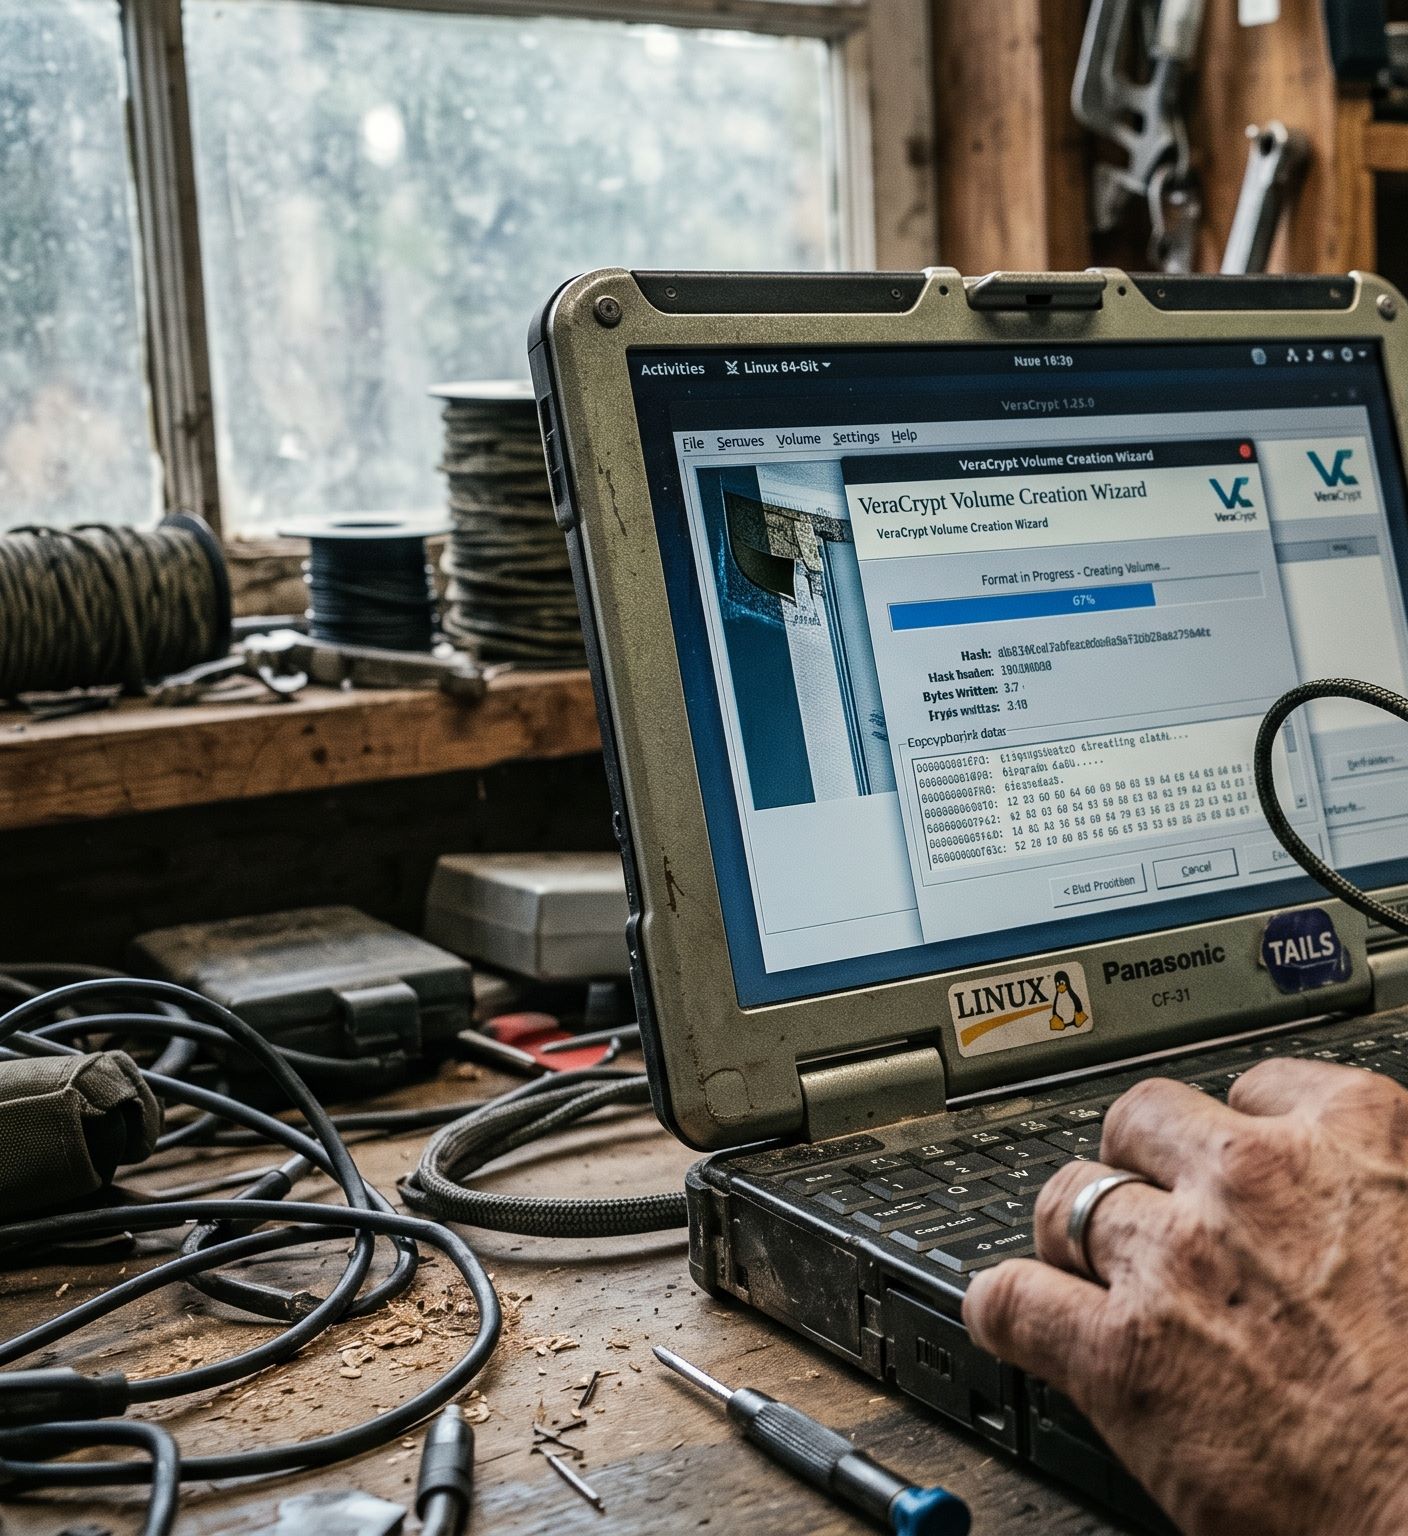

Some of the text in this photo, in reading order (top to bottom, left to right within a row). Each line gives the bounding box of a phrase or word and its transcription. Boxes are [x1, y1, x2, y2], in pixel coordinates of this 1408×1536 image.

[641, 363, 706, 376] Activities
[744, 361, 779, 374] Linux
[1001, 397, 1095, 413] VeraCrypt 1.25.0
[682, 437, 705, 451] File
[776, 433, 821, 447] Volume
[833, 430, 880, 446] Settings
[891, 428, 918, 444] Help
[959, 450, 1154, 472] VeraCrypt Volume Creation Wizard
[858, 480, 1147, 516] VeraCrypt Volume Creation Wizard
[1314, 489, 1362, 502] VeraCrypt
[1214, 511, 1257, 523] VeraCrypt
[877, 517, 1049, 540] VeraCrypt Volume Creation Wizard
[981, 573, 1018, 586] Format
[1020, 571, 1031, 583] in
[1032, 568, 1075, 584] Progress
[1083, 563, 1123, 579] Creating
[961, 648, 991, 661] Hash:
[923, 691, 954, 704] Bytes
[955, 686, 998, 699] Written:
[1268, 931, 1335, 966] TAILS
[1102, 943, 1226, 985] Panasonic
[954, 976, 1049, 1019] LINUX
[1151, 987, 1191, 1008] CF-31
